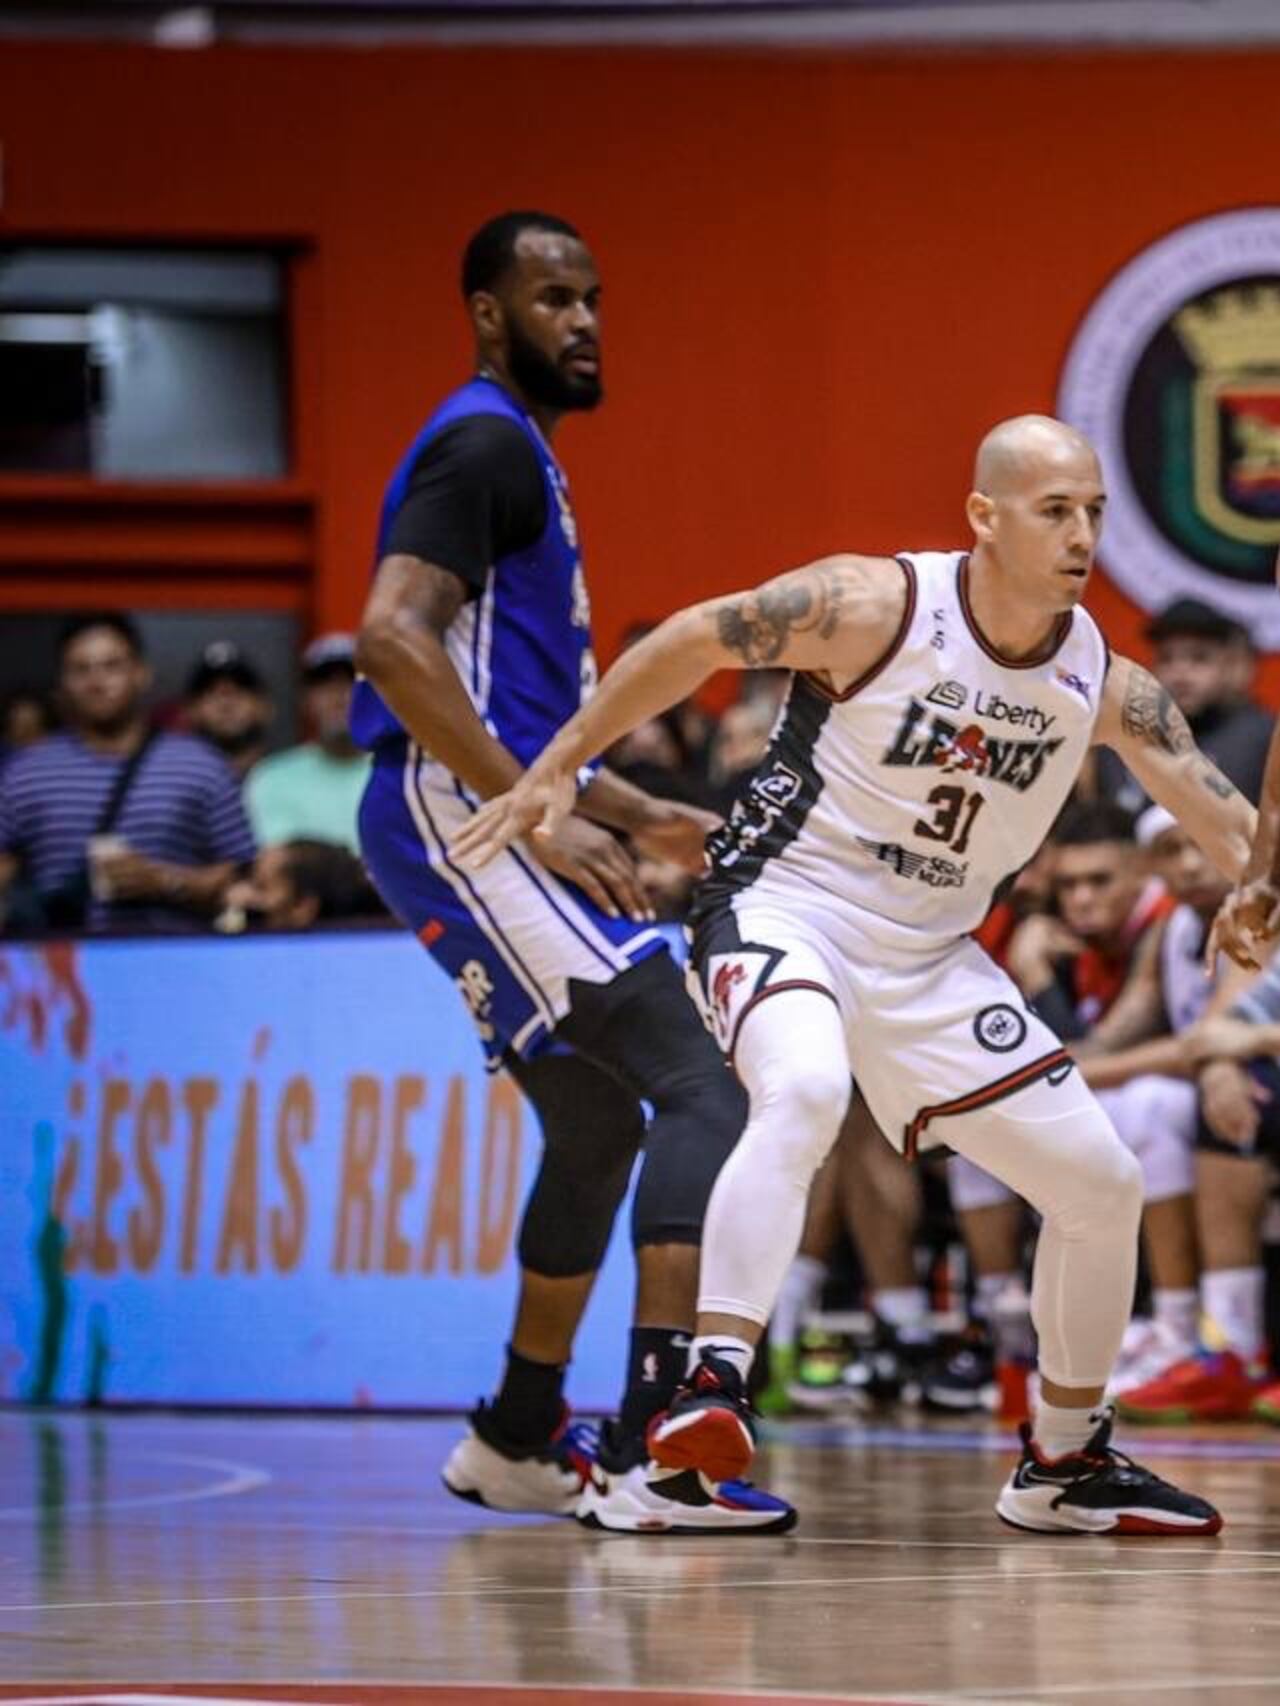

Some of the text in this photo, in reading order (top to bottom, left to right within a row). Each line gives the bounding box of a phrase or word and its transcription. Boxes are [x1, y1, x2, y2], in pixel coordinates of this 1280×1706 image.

[881, 695, 1066, 794] LENES
[974, 691, 1056, 736] Liberty
[913, 785, 985, 855] 31
